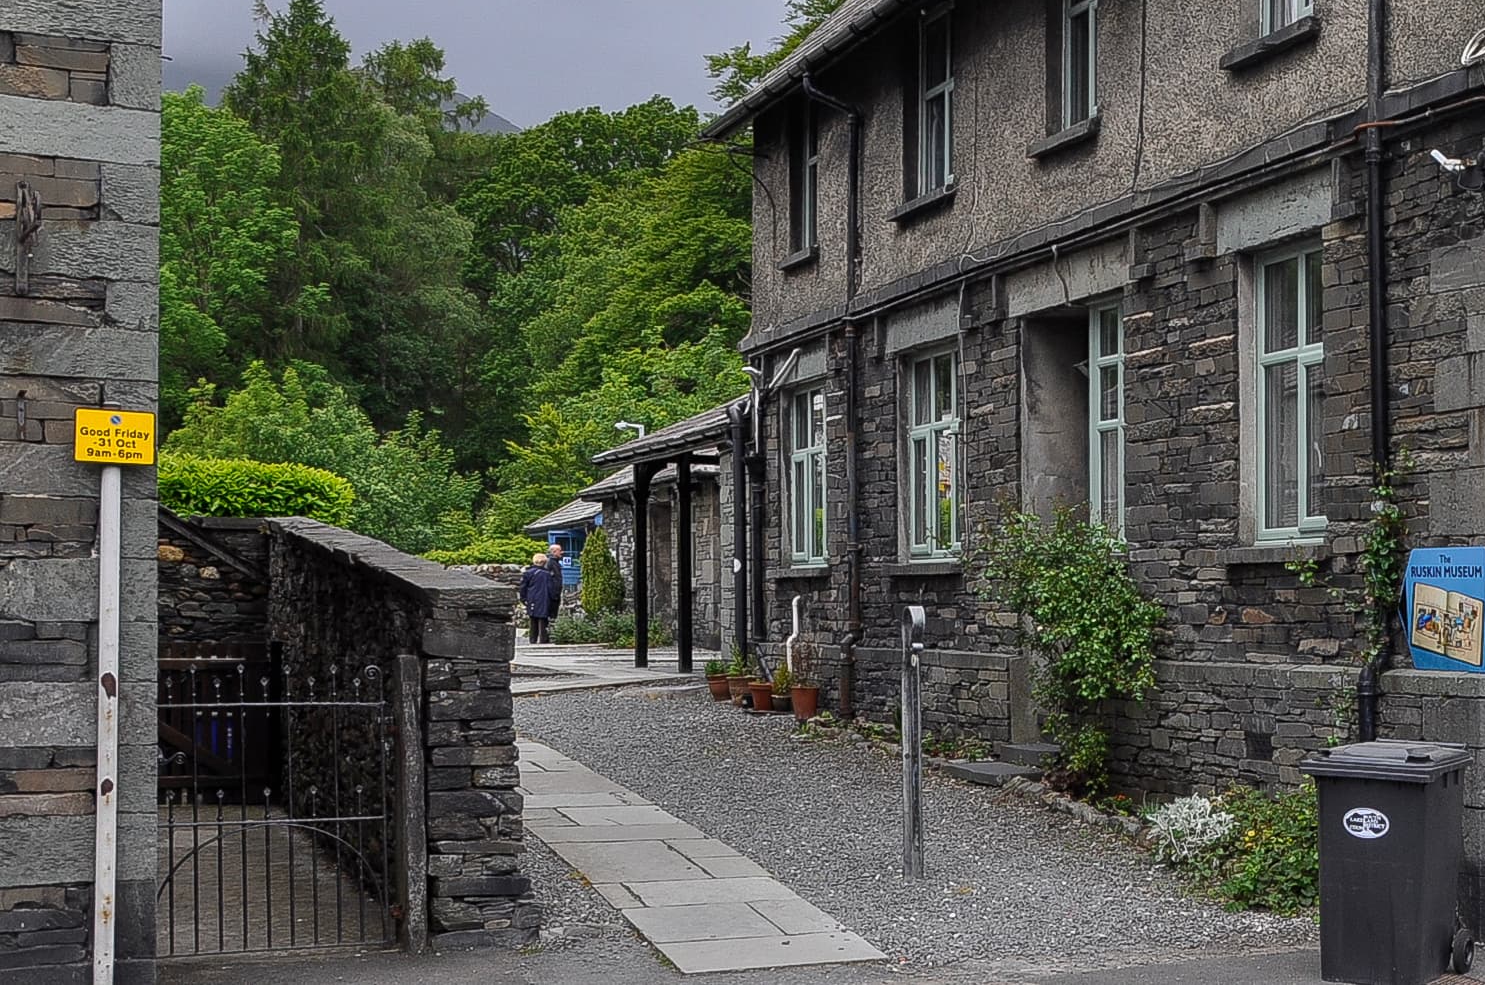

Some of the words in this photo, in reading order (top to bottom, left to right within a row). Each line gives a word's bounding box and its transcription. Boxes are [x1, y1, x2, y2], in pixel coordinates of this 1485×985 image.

[80, 426, 110, 437] Good
[114, 428, 150, 441] Friday
[115, 439, 137, 449] Oct
[1439, 554, 1451, 564] The
[1411, 565, 1442, 578] RUSKIN
[1444, 565, 1483, 578] MUSEUM
